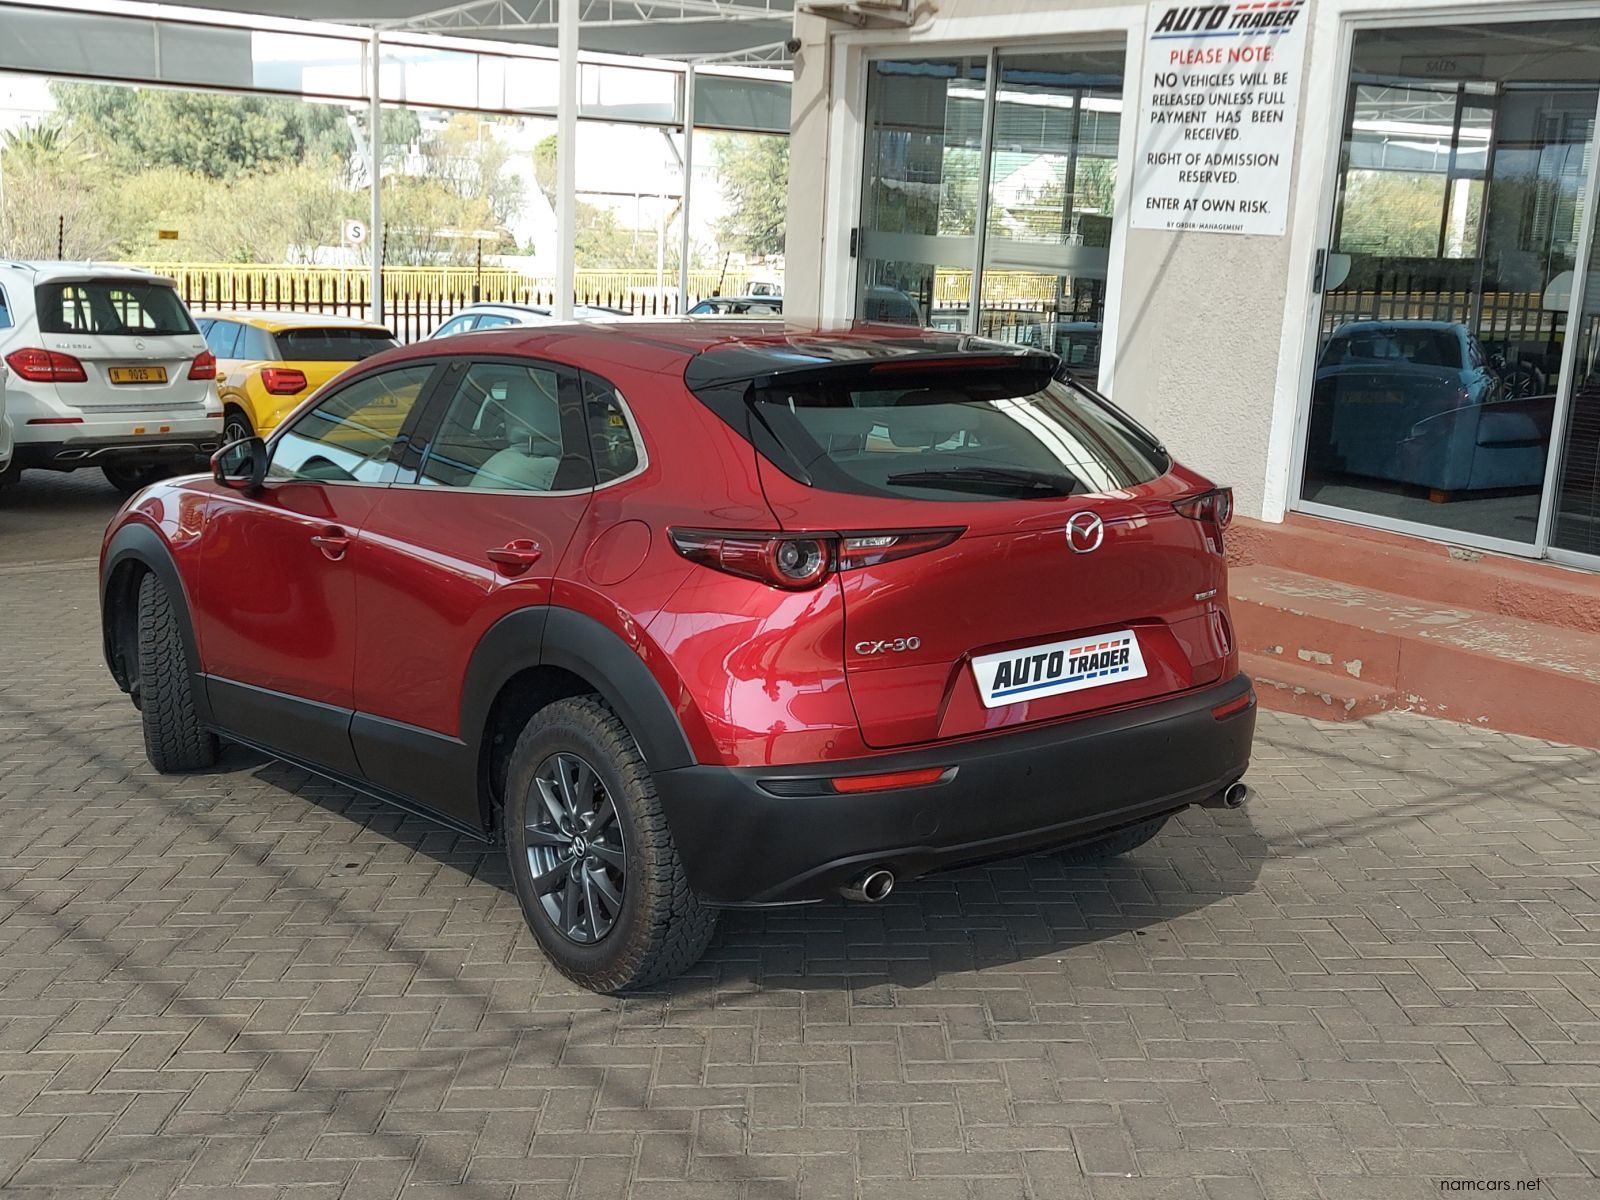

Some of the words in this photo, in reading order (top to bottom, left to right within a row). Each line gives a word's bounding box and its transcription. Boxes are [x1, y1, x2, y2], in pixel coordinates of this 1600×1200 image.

[1154, 4, 1231, 33] AUTO
[1228, 9, 1300, 30] TRADER
[1170, 48, 1222, 65] PLEASE
[1228, 46, 1274, 64] NOTE:
[1154, 72, 1178, 88] NO
[1182, 73, 1235, 88] VEHICLES
[1240, 73, 1269, 86] WILL
[1273, 72, 1289, 85] BE
[1152, 93, 1205, 107] RELEASED
[1208, 92, 1254, 106] UNLESS
[1257, 91, 1286, 104] FULL
[1150, 111, 1207, 124] PAYMENT
[1216, 111, 1242, 123] HAS
[1252, 110, 1284, 123] BEEN
[1184, 128, 1242, 141] RECEIVED.
[1147, 152, 1182, 165] RIGHT
[1185, 153, 1201, 165] OF
[1204, 153, 1279, 167] ADMISSION
[1178, 170, 1240, 184] RESERVED.
[1146, 197, 1180, 211] ENTER
[1183, 199, 1198, 212] AT
[1201, 200, 1235, 213] OWN
[1239, 200, 1271, 214] RISK.
[352, 226, 361, 238] S
[1199, 223, 1244, 232] MANAGEMENT
[855, 636, 921, 655] CX-30
[992, 650, 1063, 691] AUTO
[1068, 647, 1130, 676] TRADER
